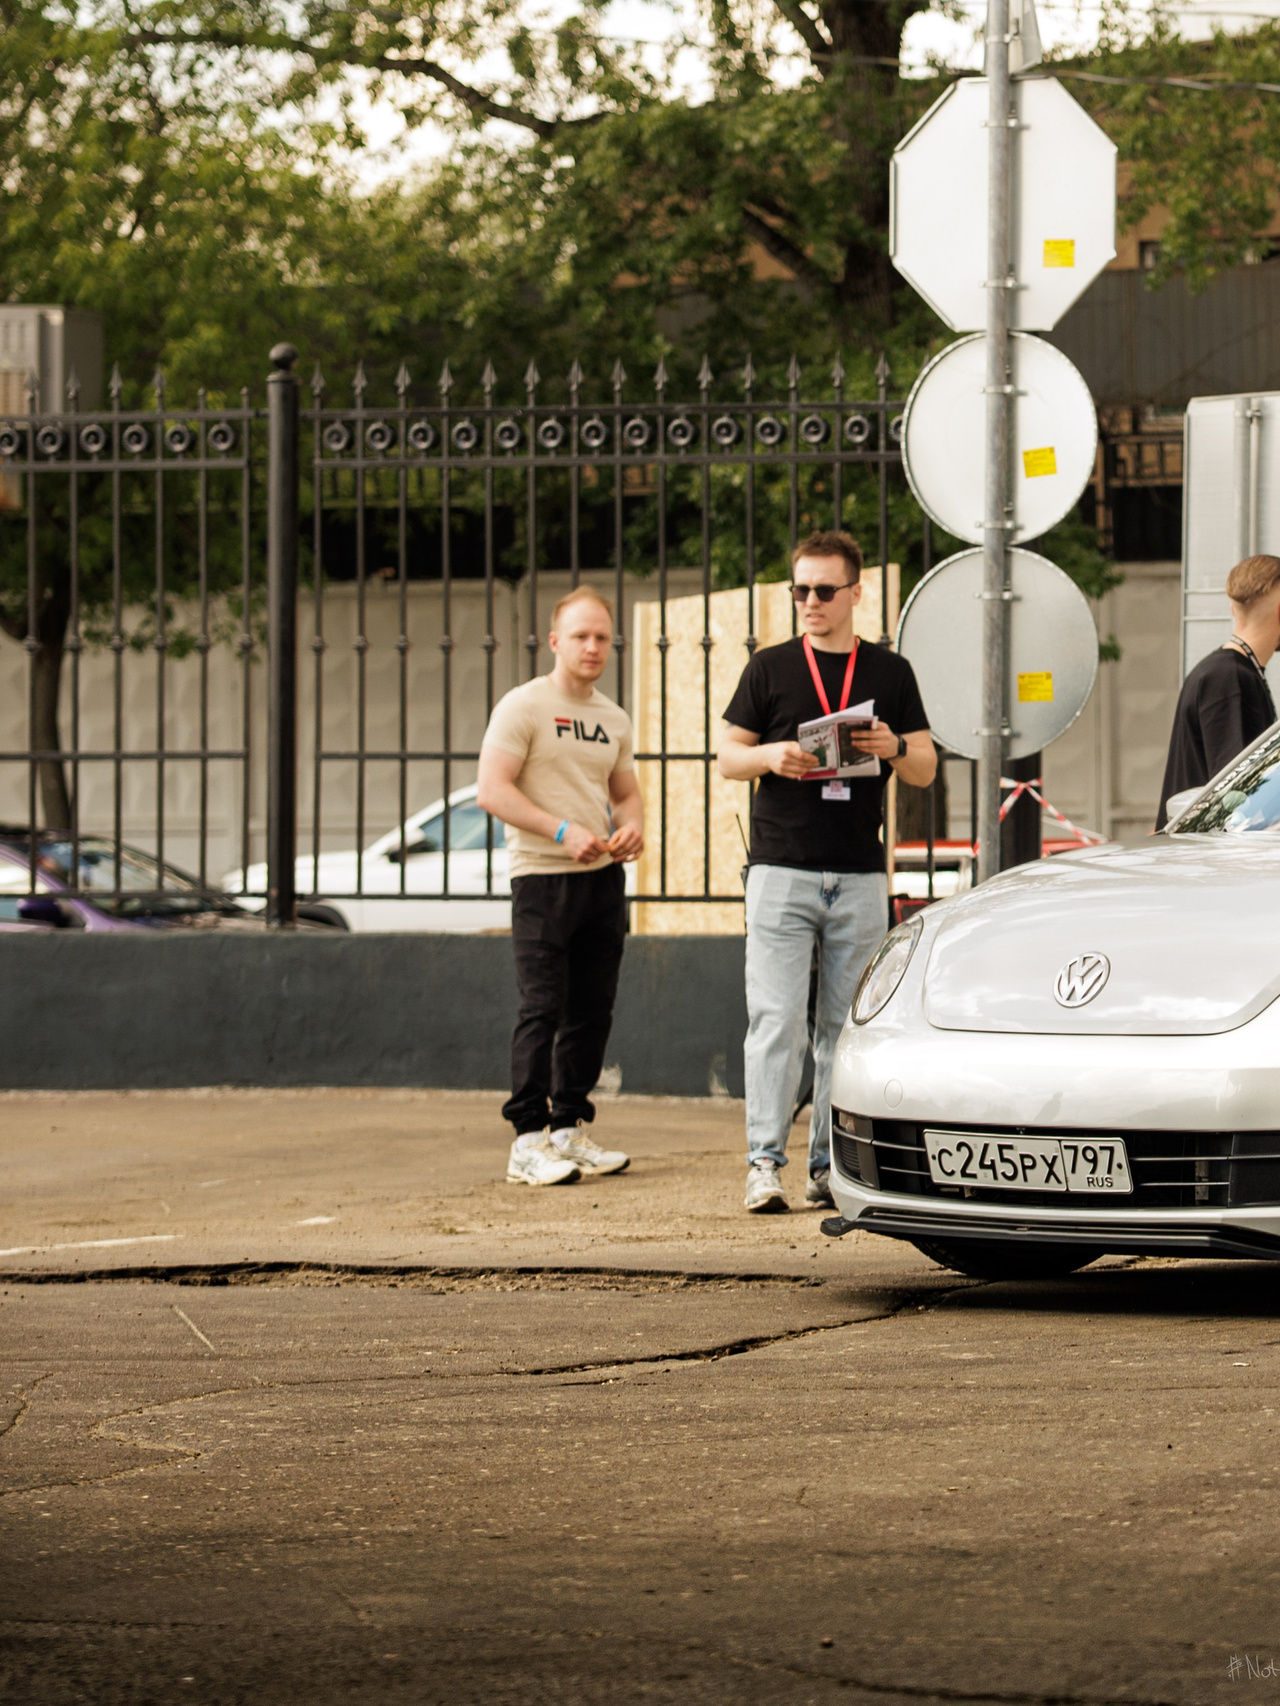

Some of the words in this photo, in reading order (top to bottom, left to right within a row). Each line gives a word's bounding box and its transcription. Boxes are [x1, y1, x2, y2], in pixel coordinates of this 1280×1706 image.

[554, 717, 610, 745] FILA
[1063, 1144, 1115, 1175] 797
[1086, 1177, 1114, 1188] RUS
